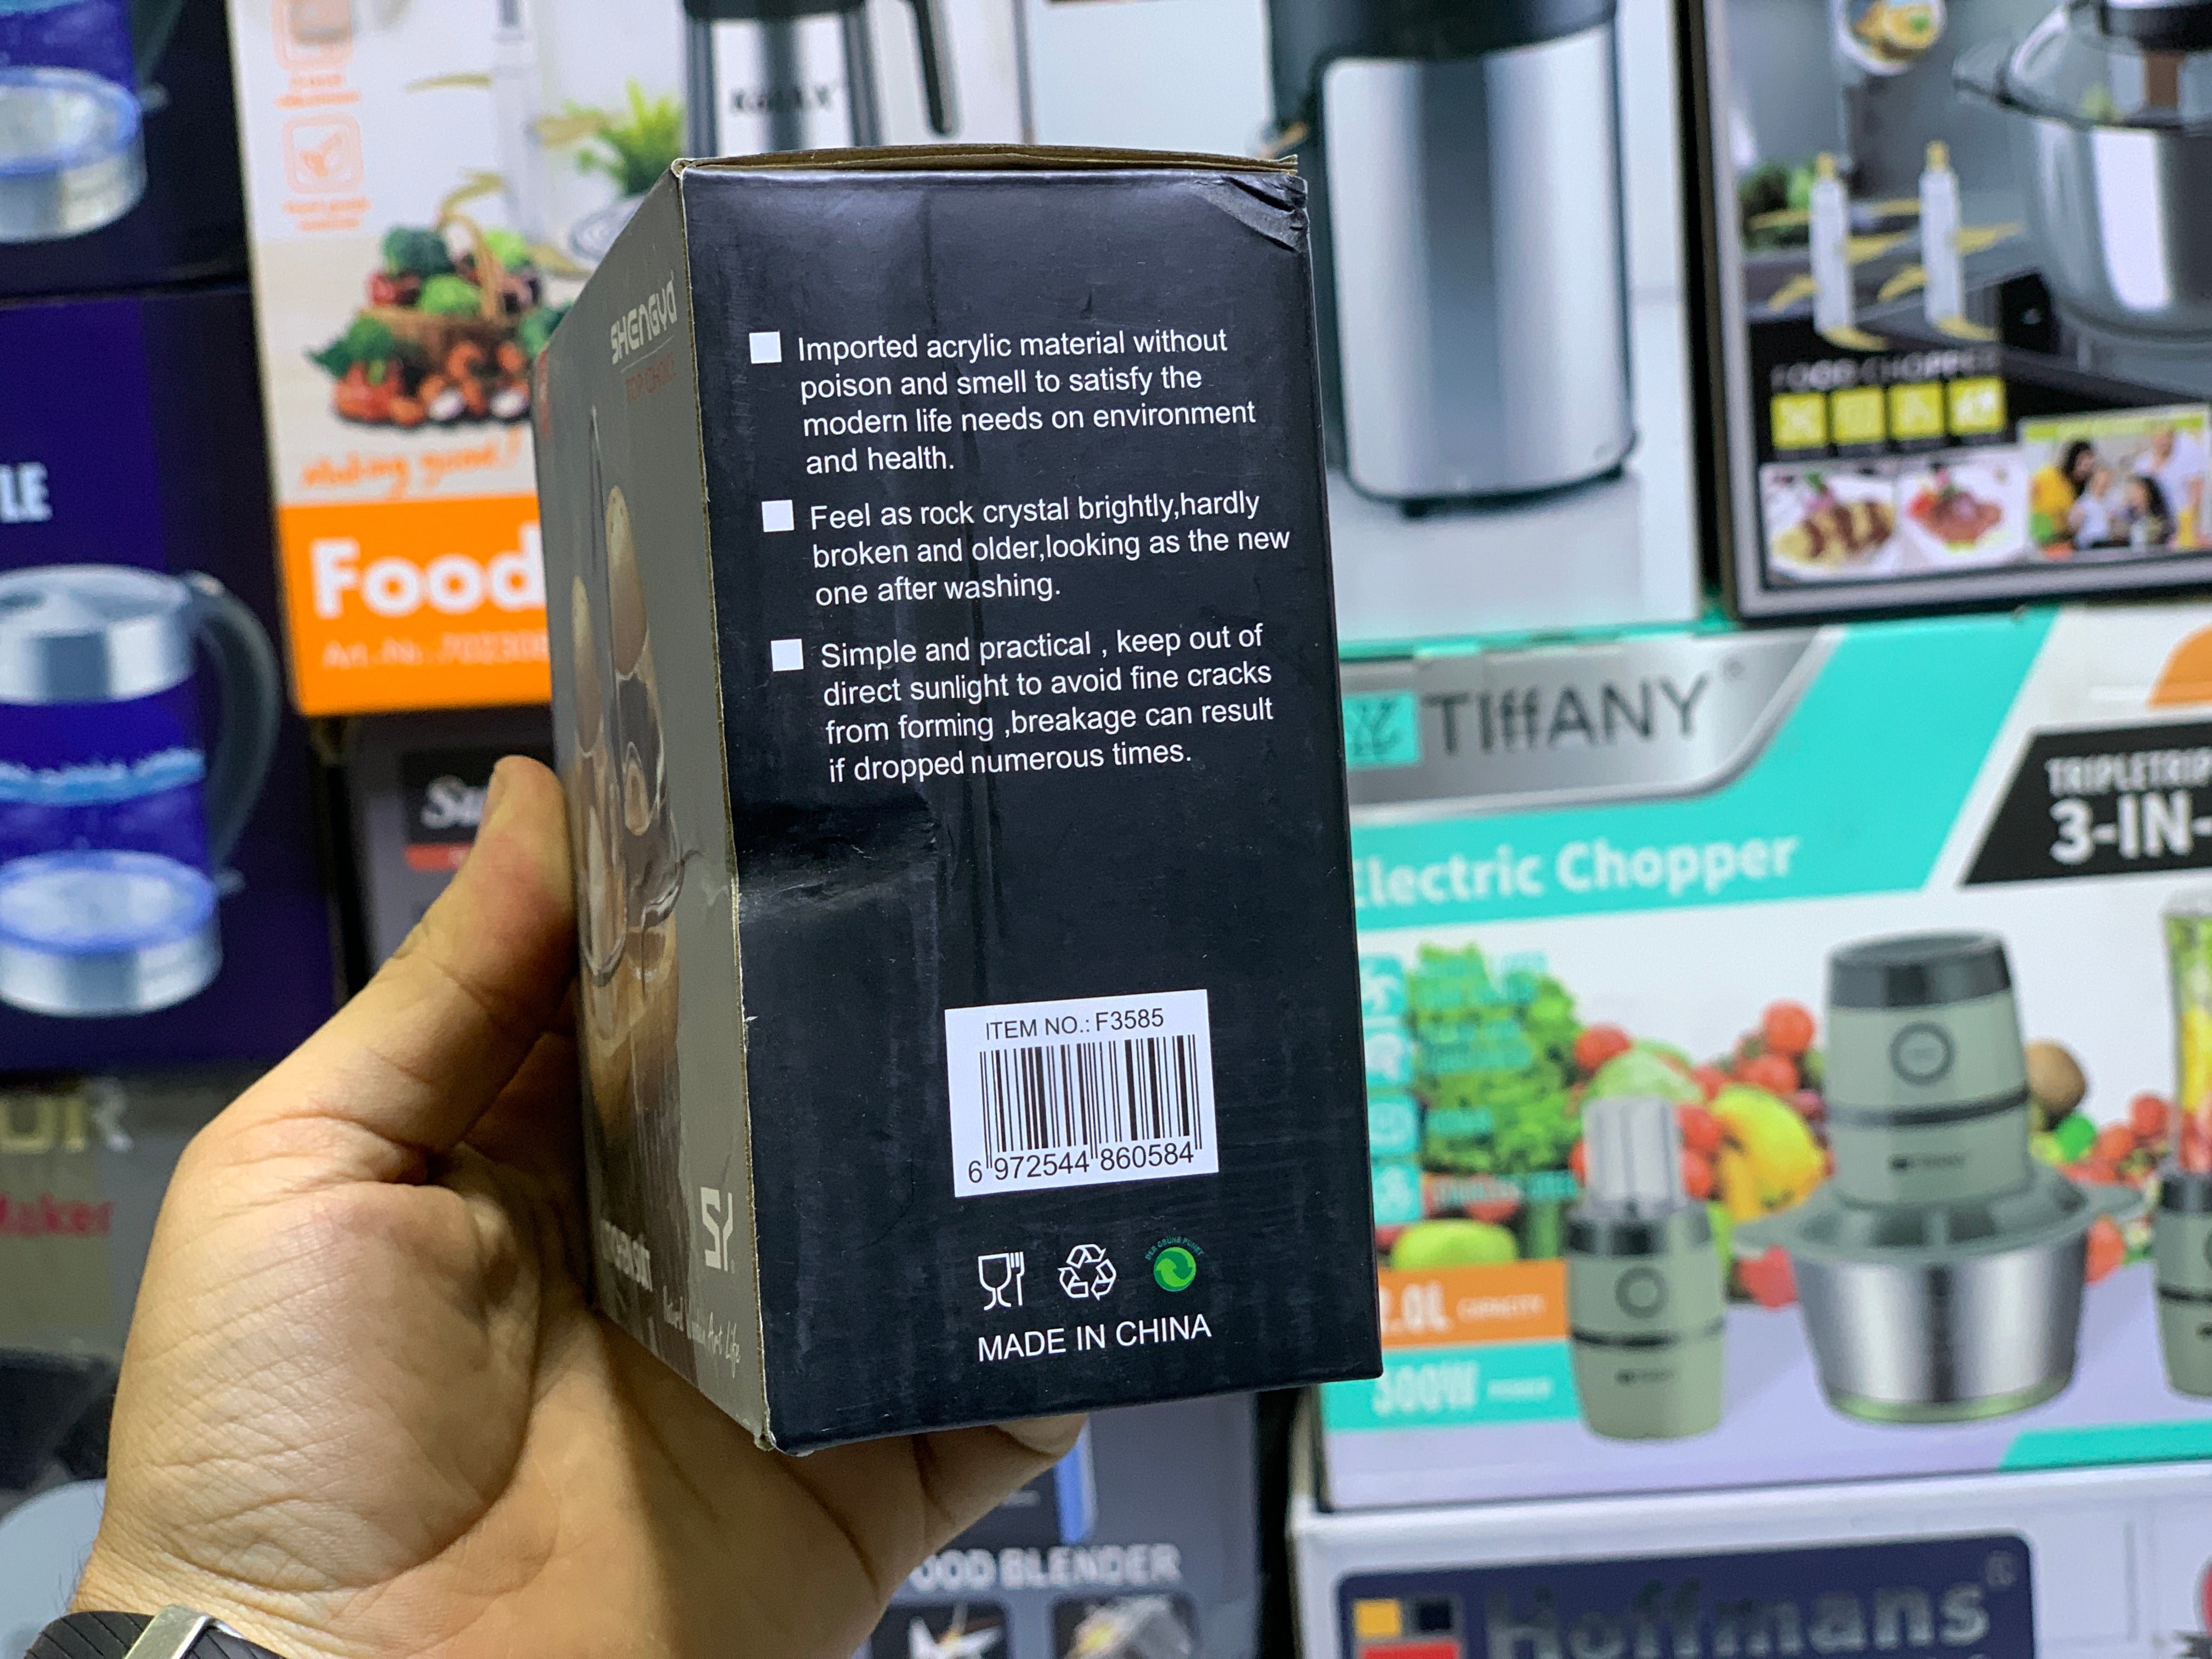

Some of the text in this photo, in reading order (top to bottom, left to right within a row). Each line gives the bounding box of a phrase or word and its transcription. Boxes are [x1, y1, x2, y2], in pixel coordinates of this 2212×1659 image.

[799, 329, 1227, 365] Imported acrylic material without
[801, 366, 1201, 405] poison and smell to satisfy the
[804, 401, 1256, 436] modern life needs on environment
[806, 446, 953, 475] and health.
[811, 490, 1260, 530] Feel as rock crystal brightly,hardly
[813, 528, 1290, 568] broken and older,looking as the new
[309, 521, 547, 619] Food
[816, 573, 1060, 606] one after washing.
[822, 639, 916, 670] Simple
[926, 637, 969, 662] and
[980, 631, 1090, 665] practical
[1117, 630, 1181, 656] keep
[1190, 626, 1231, 649] out
[1239, 623, 1263, 647] of
[824, 661, 1271, 706] direct sunlight to avoid fine cracks
[826, 697, 1273, 744] from forming ,breakage can result
[830, 742, 1191, 783] if dropped numerous times.
[1556, 836, 1799, 896] Chopper
[986, 1019, 1037, 1040] ITEM
[1096, 1008, 1163, 1031] F3585
[969, 1141, 1193, 1183] 6 972544 860584
[979, 1314, 1212, 1362] MADE IN CHINA
[911, 1543, 1182, 1592] OOD BLENDER
